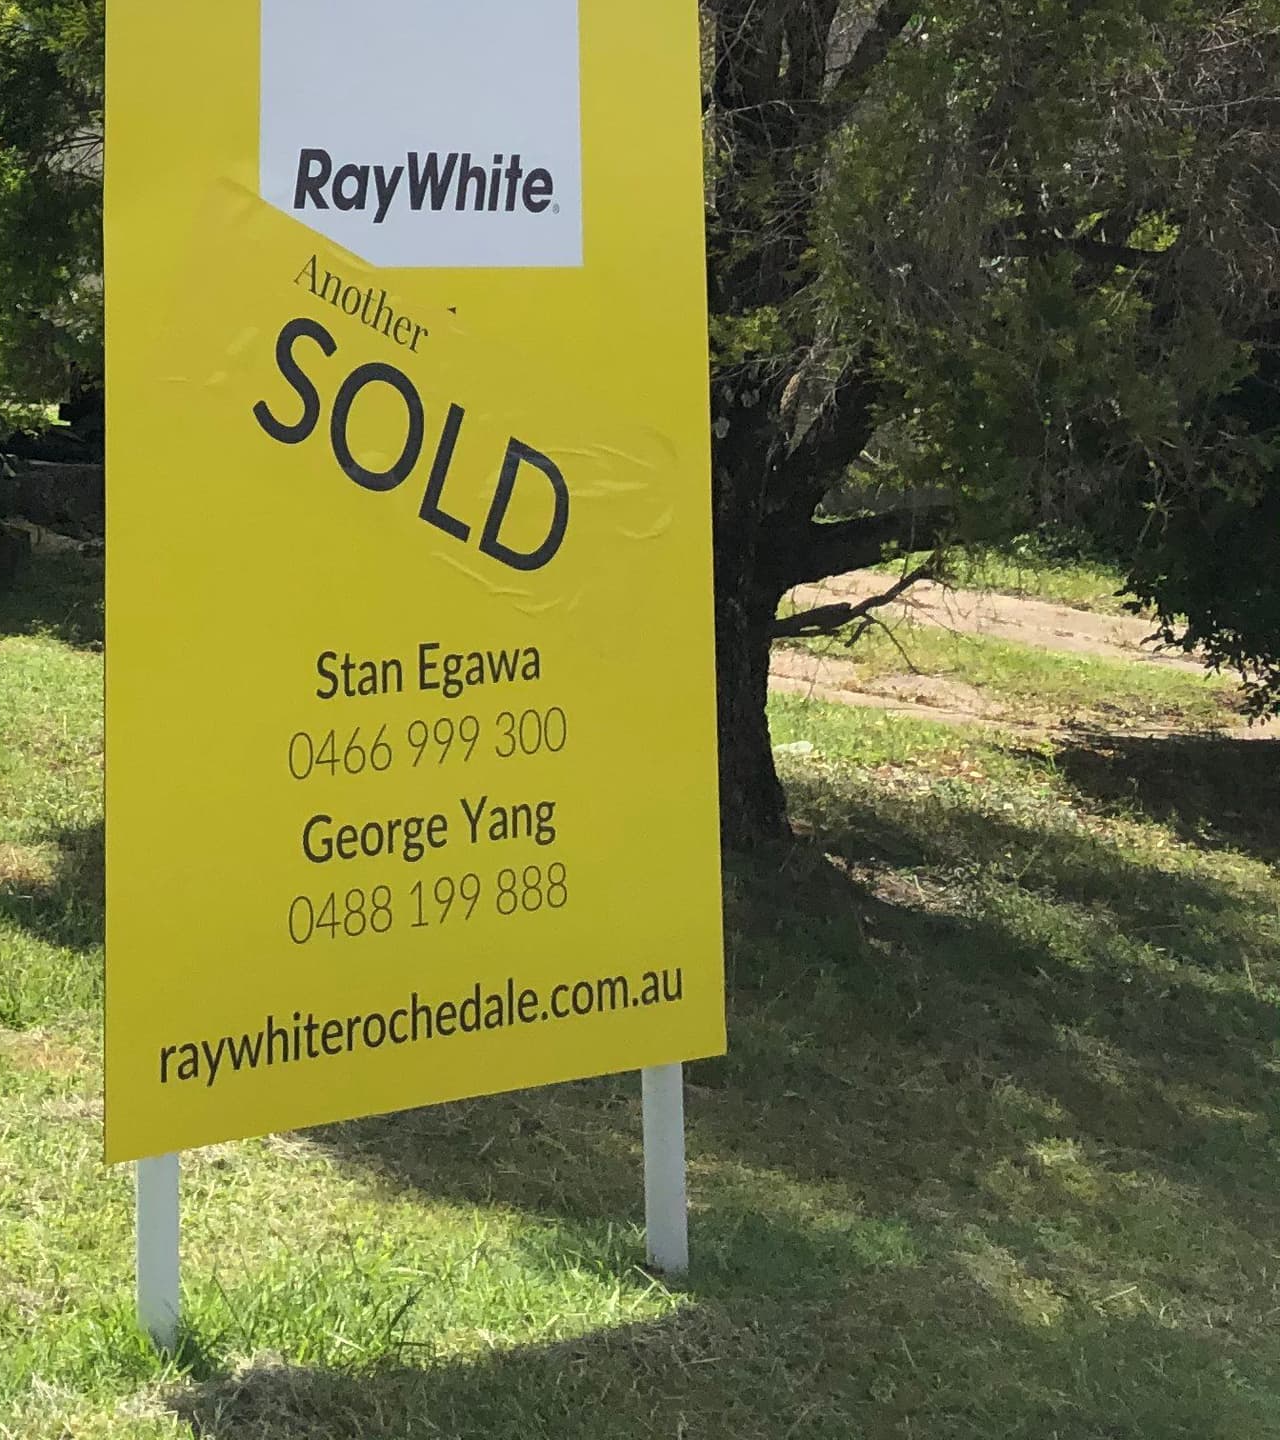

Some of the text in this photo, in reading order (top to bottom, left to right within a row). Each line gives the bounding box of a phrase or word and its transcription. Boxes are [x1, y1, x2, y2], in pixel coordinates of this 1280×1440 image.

[293, 254, 429, 355] Another
[253, 317, 570, 571] SOLD
[317, 643, 541, 699] Stan Egawa
[289, 707, 567, 780] 0466 999 300
[303, 796, 557, 863] George Yang
[289, 863, 568, 945] 0488 199 888
[161, 968, 684, 1088] raywhiterochedale.com.au
